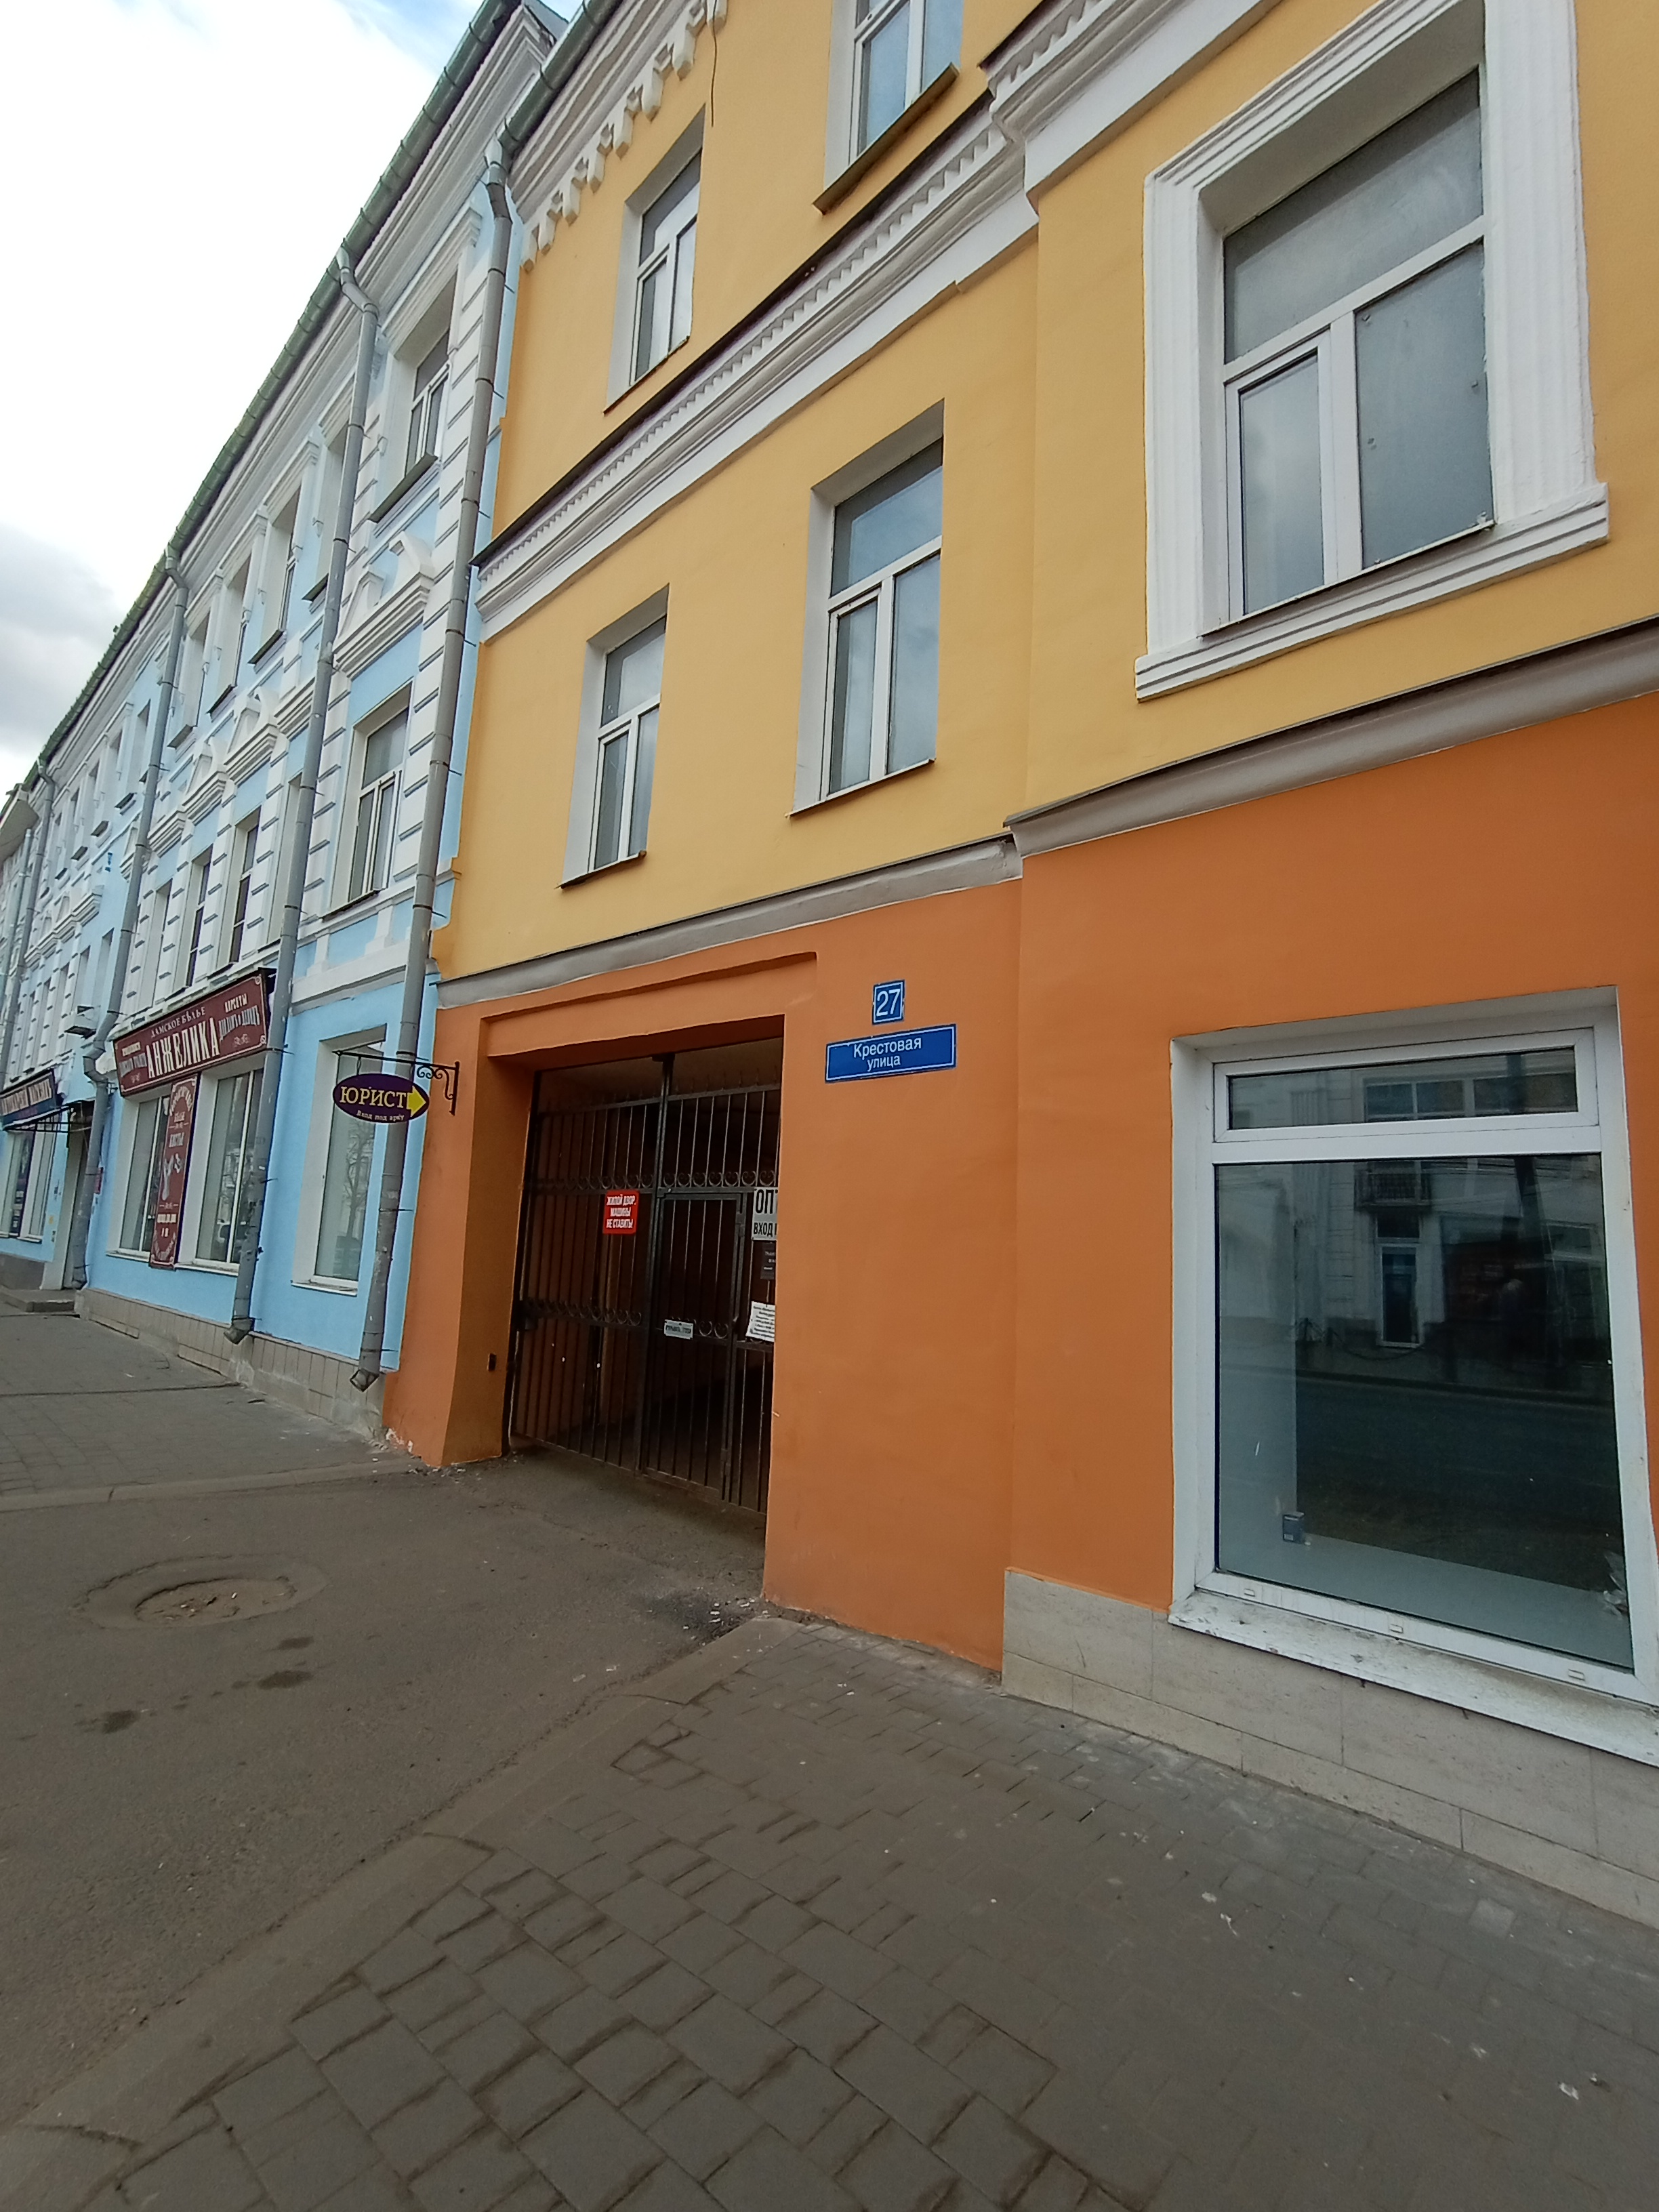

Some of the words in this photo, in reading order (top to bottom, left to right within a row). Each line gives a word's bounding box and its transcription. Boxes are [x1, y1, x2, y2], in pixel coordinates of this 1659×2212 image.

[876, 988, 901, 1017] 27
[150, 1017, 181, 1038] ДАМСКОЕ
[146, 1017, 220, 1080] АНЖЕЛИКА
[853, 1037, 922, 1061] Крестовая
[867, 1054, 901, 1071] улица
[340, 1086, 407, 1109] ЮРИСТ
[374, 1113, 388, 1122] под
[607, 1218, 613, 1228] НЕ
[753, 1222, 773, 1237] ВХОД
